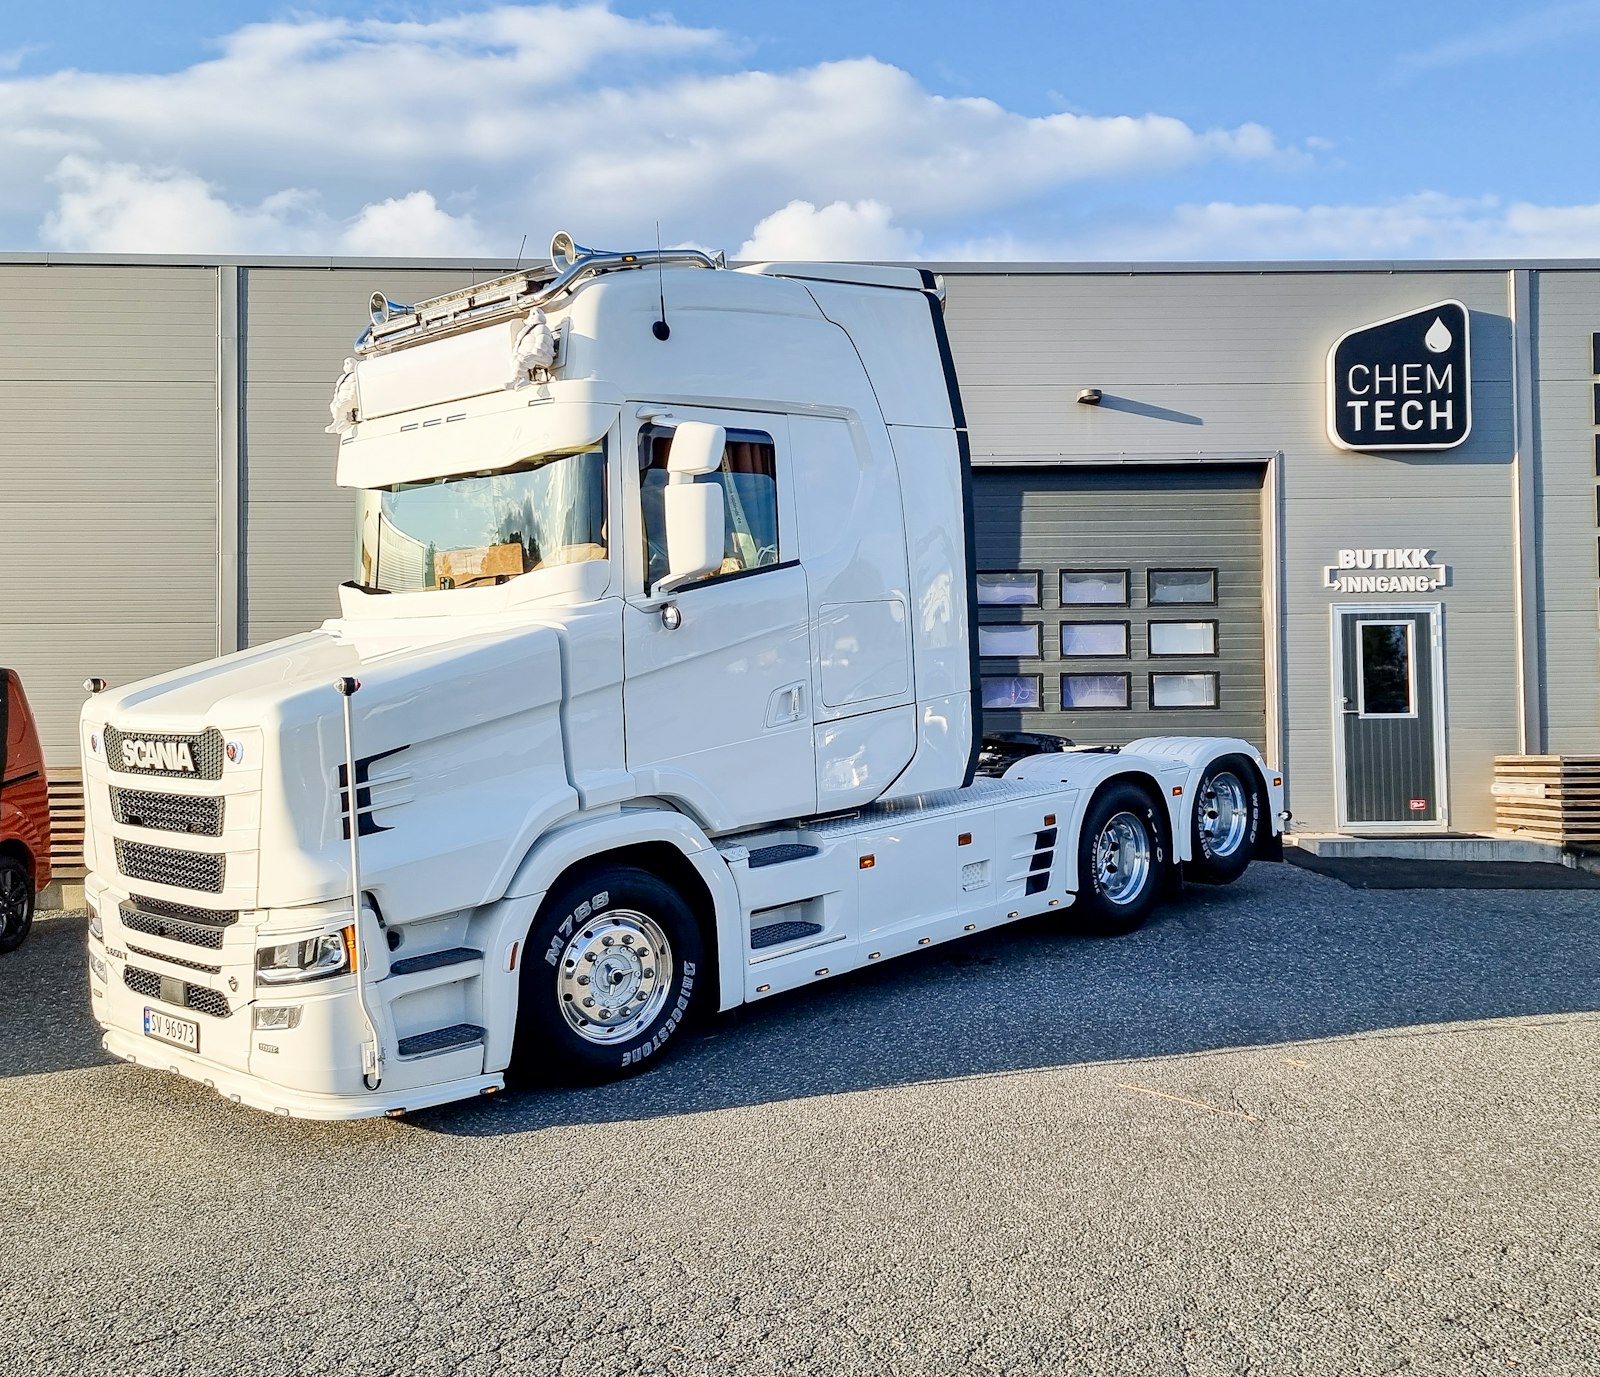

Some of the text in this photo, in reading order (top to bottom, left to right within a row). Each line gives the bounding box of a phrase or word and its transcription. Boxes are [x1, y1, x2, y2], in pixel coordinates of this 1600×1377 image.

[1348, 363, 1453, 395] CHEM
[1346, 400, 1454, 432] TECH
[1338, 549, 1431, 569] BUTIKK
[1340, 576, 1430, 593] INNGANG
[121, 738, 196, 772] SCANIA
[544, 890, 610, 967] M788
[151, 1013, 195, 1044] SV 96973
[620, 959, 696, 1067] BRIDGESTONE
